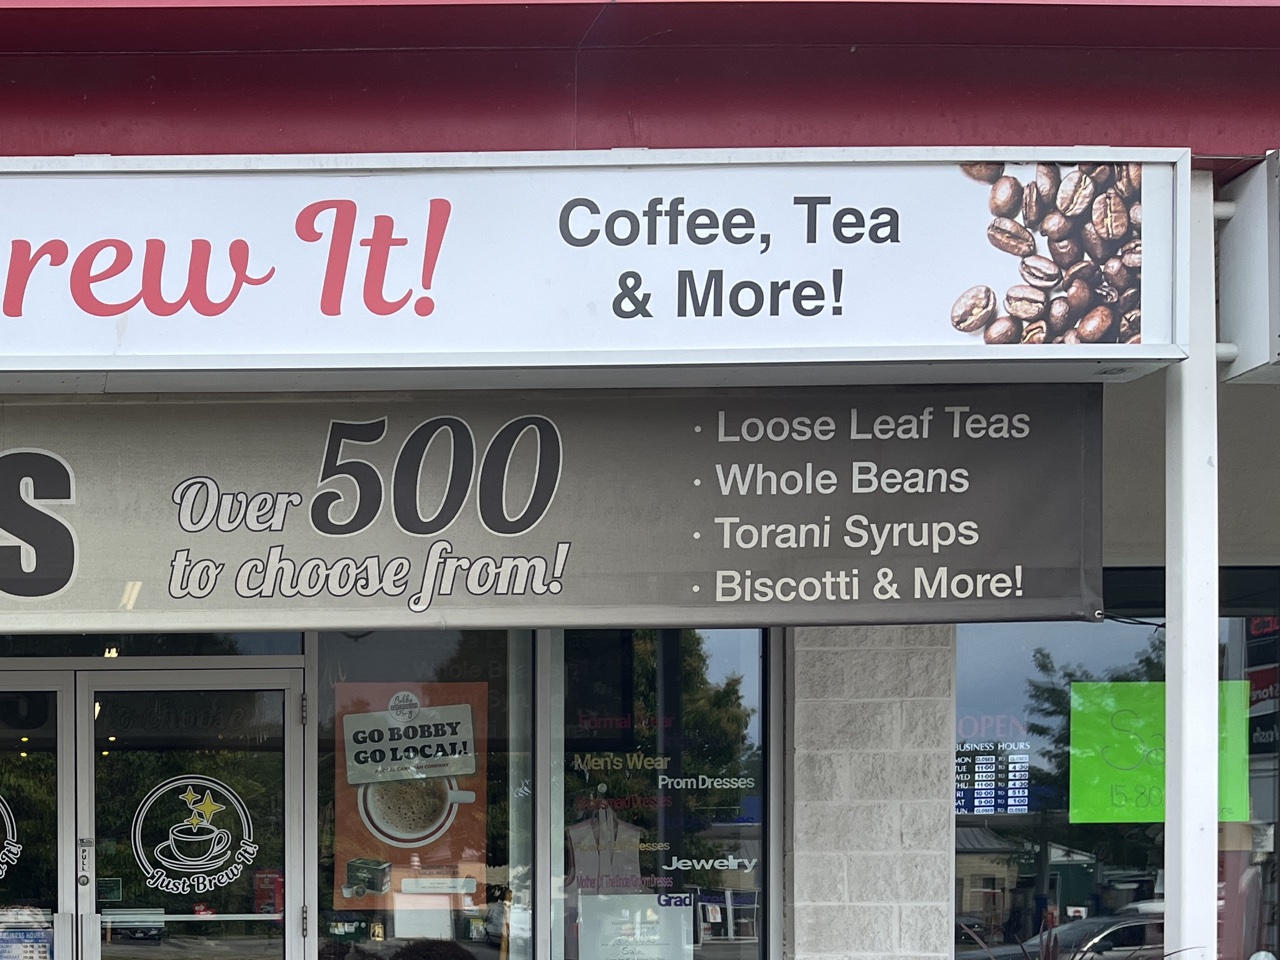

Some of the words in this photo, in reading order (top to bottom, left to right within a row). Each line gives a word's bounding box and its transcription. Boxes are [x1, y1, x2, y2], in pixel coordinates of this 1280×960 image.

[558, 195, 771, 256] Coffee,
[792, 195, 901, 246] Tea
[294, 198, 452, 318] It!
[611, 270, 654, 319] &
[675, 268, 845, 320] More!
[717, 410, 837, 443] Loose
[849, 407, 934, 440] Leaf
[944, 406, 1031, 439] Teas
[172, 476, 302, 533] Over
[309, 415, 564, 537] 500
[715, 462, 838, 497] Whole
[851, 461, 970, 494] Beans
[714, 515, 832, 549] Torani
[843, 514, 980, 555] Syrups
[167, 548, 225, 599] to
[234, 545, 412, 598] choose
[408, 540, 572, 613] from!
[716, 569, 859, 602] Biscotti
[872, 567, 901, 600] &
[913, 565, 1024, 600] More!
[353, 729, 384, 744] GO
[389, 721, 461, 741] BOBBY
[958, 715, 1027, 738] OPEN
[1102, 709, 1165, 771] Sa
[354, 748, 386, 765] GO
[390, 741, 468, 762] LOCAL!
[626, 755, 670, 770] Wear
[997, 742, 1030, 751] HOURS
[658, 775, 697, 789] Prom
[699, 775, 755, 789] Dresses
[146, 868, 190, 894] Just
[191, 863, 243, 893] Brew
[661, 855, 757, 873] Jewelry
[657, 892, 693, 907] Grad
